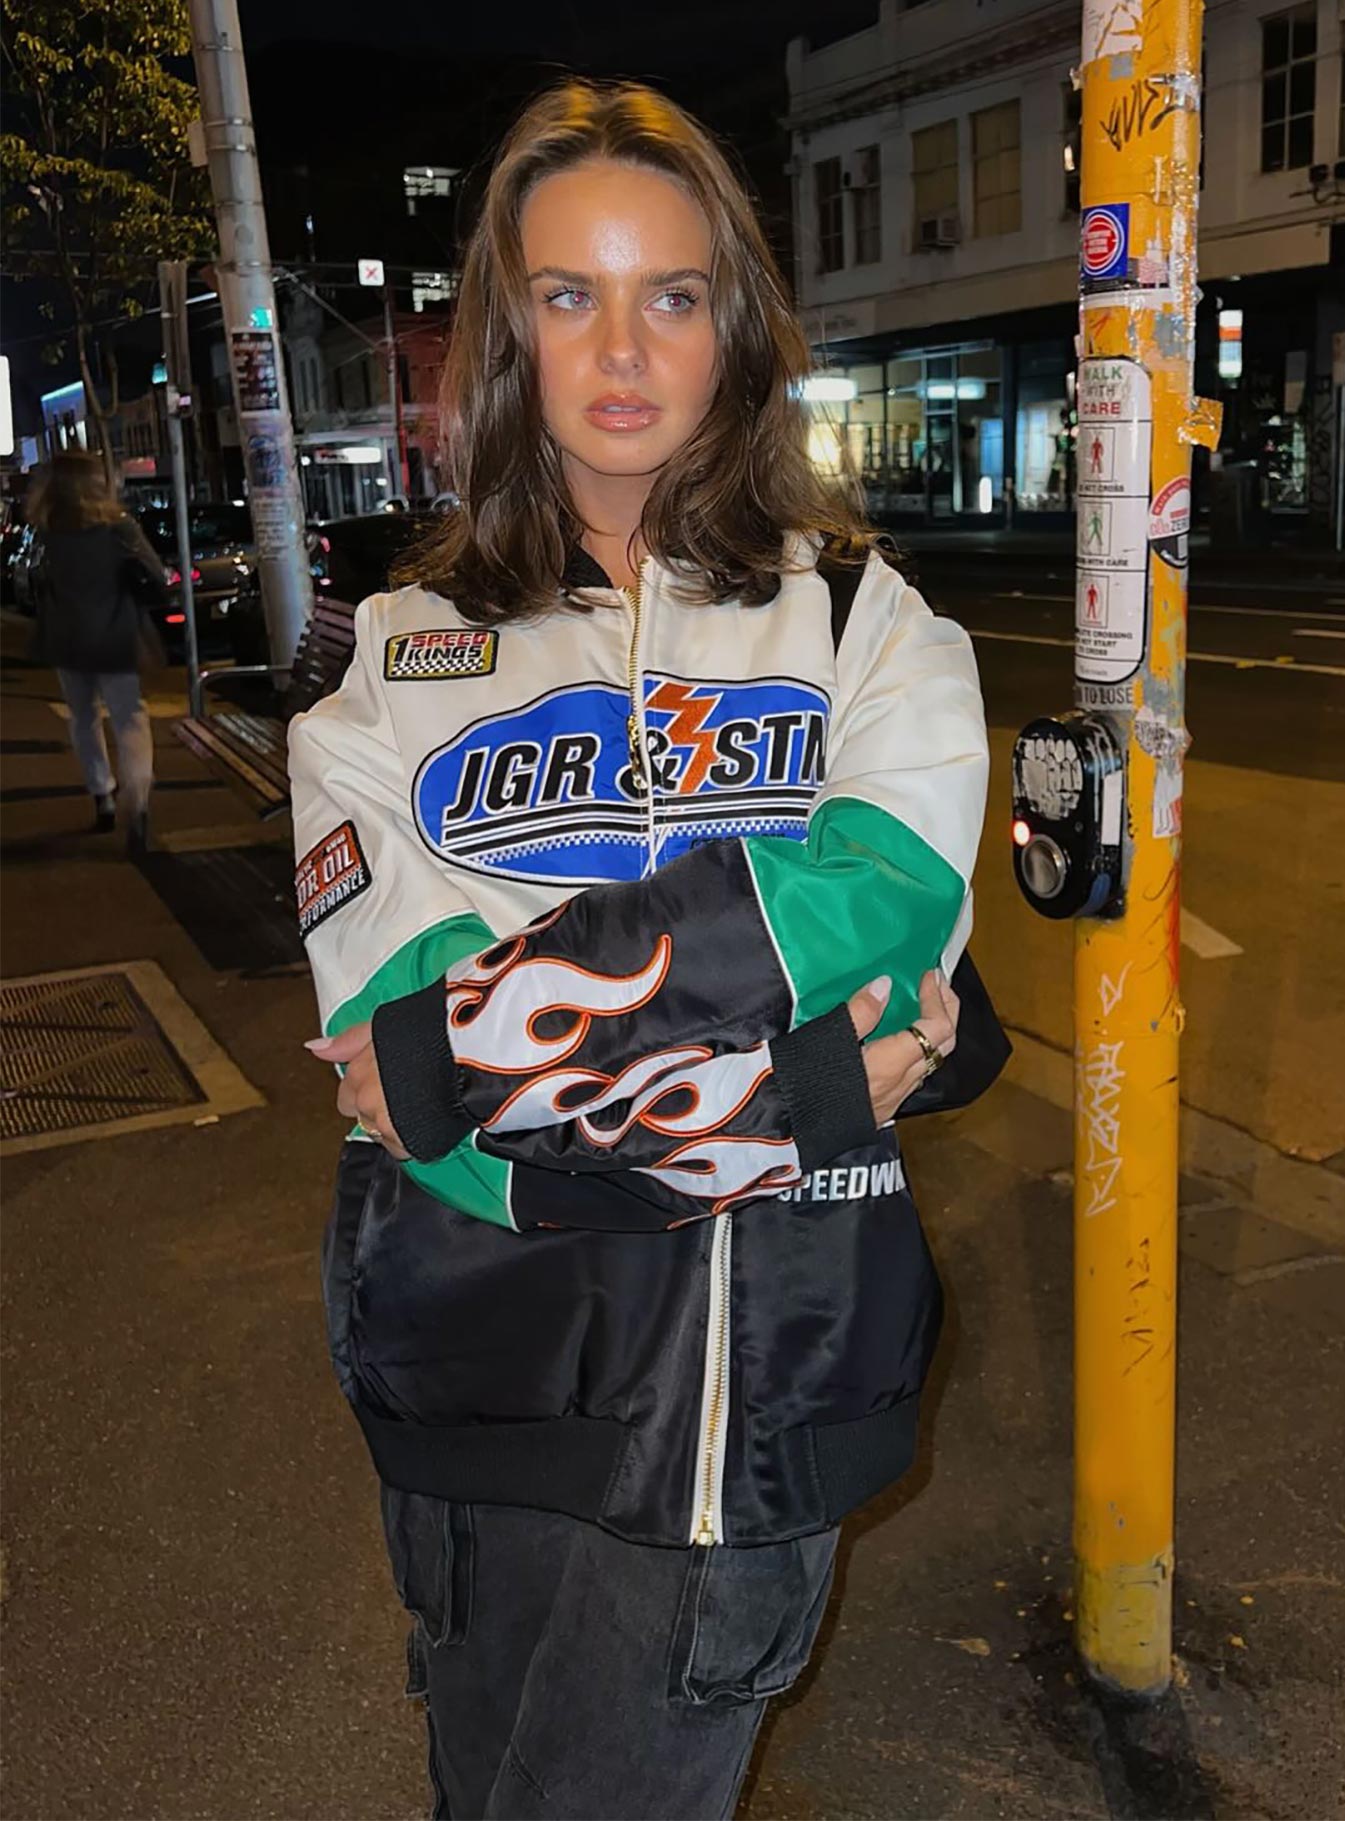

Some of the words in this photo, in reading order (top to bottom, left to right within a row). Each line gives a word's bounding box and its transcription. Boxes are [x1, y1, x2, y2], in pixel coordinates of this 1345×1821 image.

[1083, 402, 1121, 415] CARE
[394, 637, 410, 662] 1
[408, 645, 483, 661] KINGS
[411, 632, 489, 649] SPEED
[444, 732, 601, 822] JGR
[615, 730, 682, 803] &
[323, 843, 355, 884] OIL
[299, 868, 366, 937] RFORMANCE
